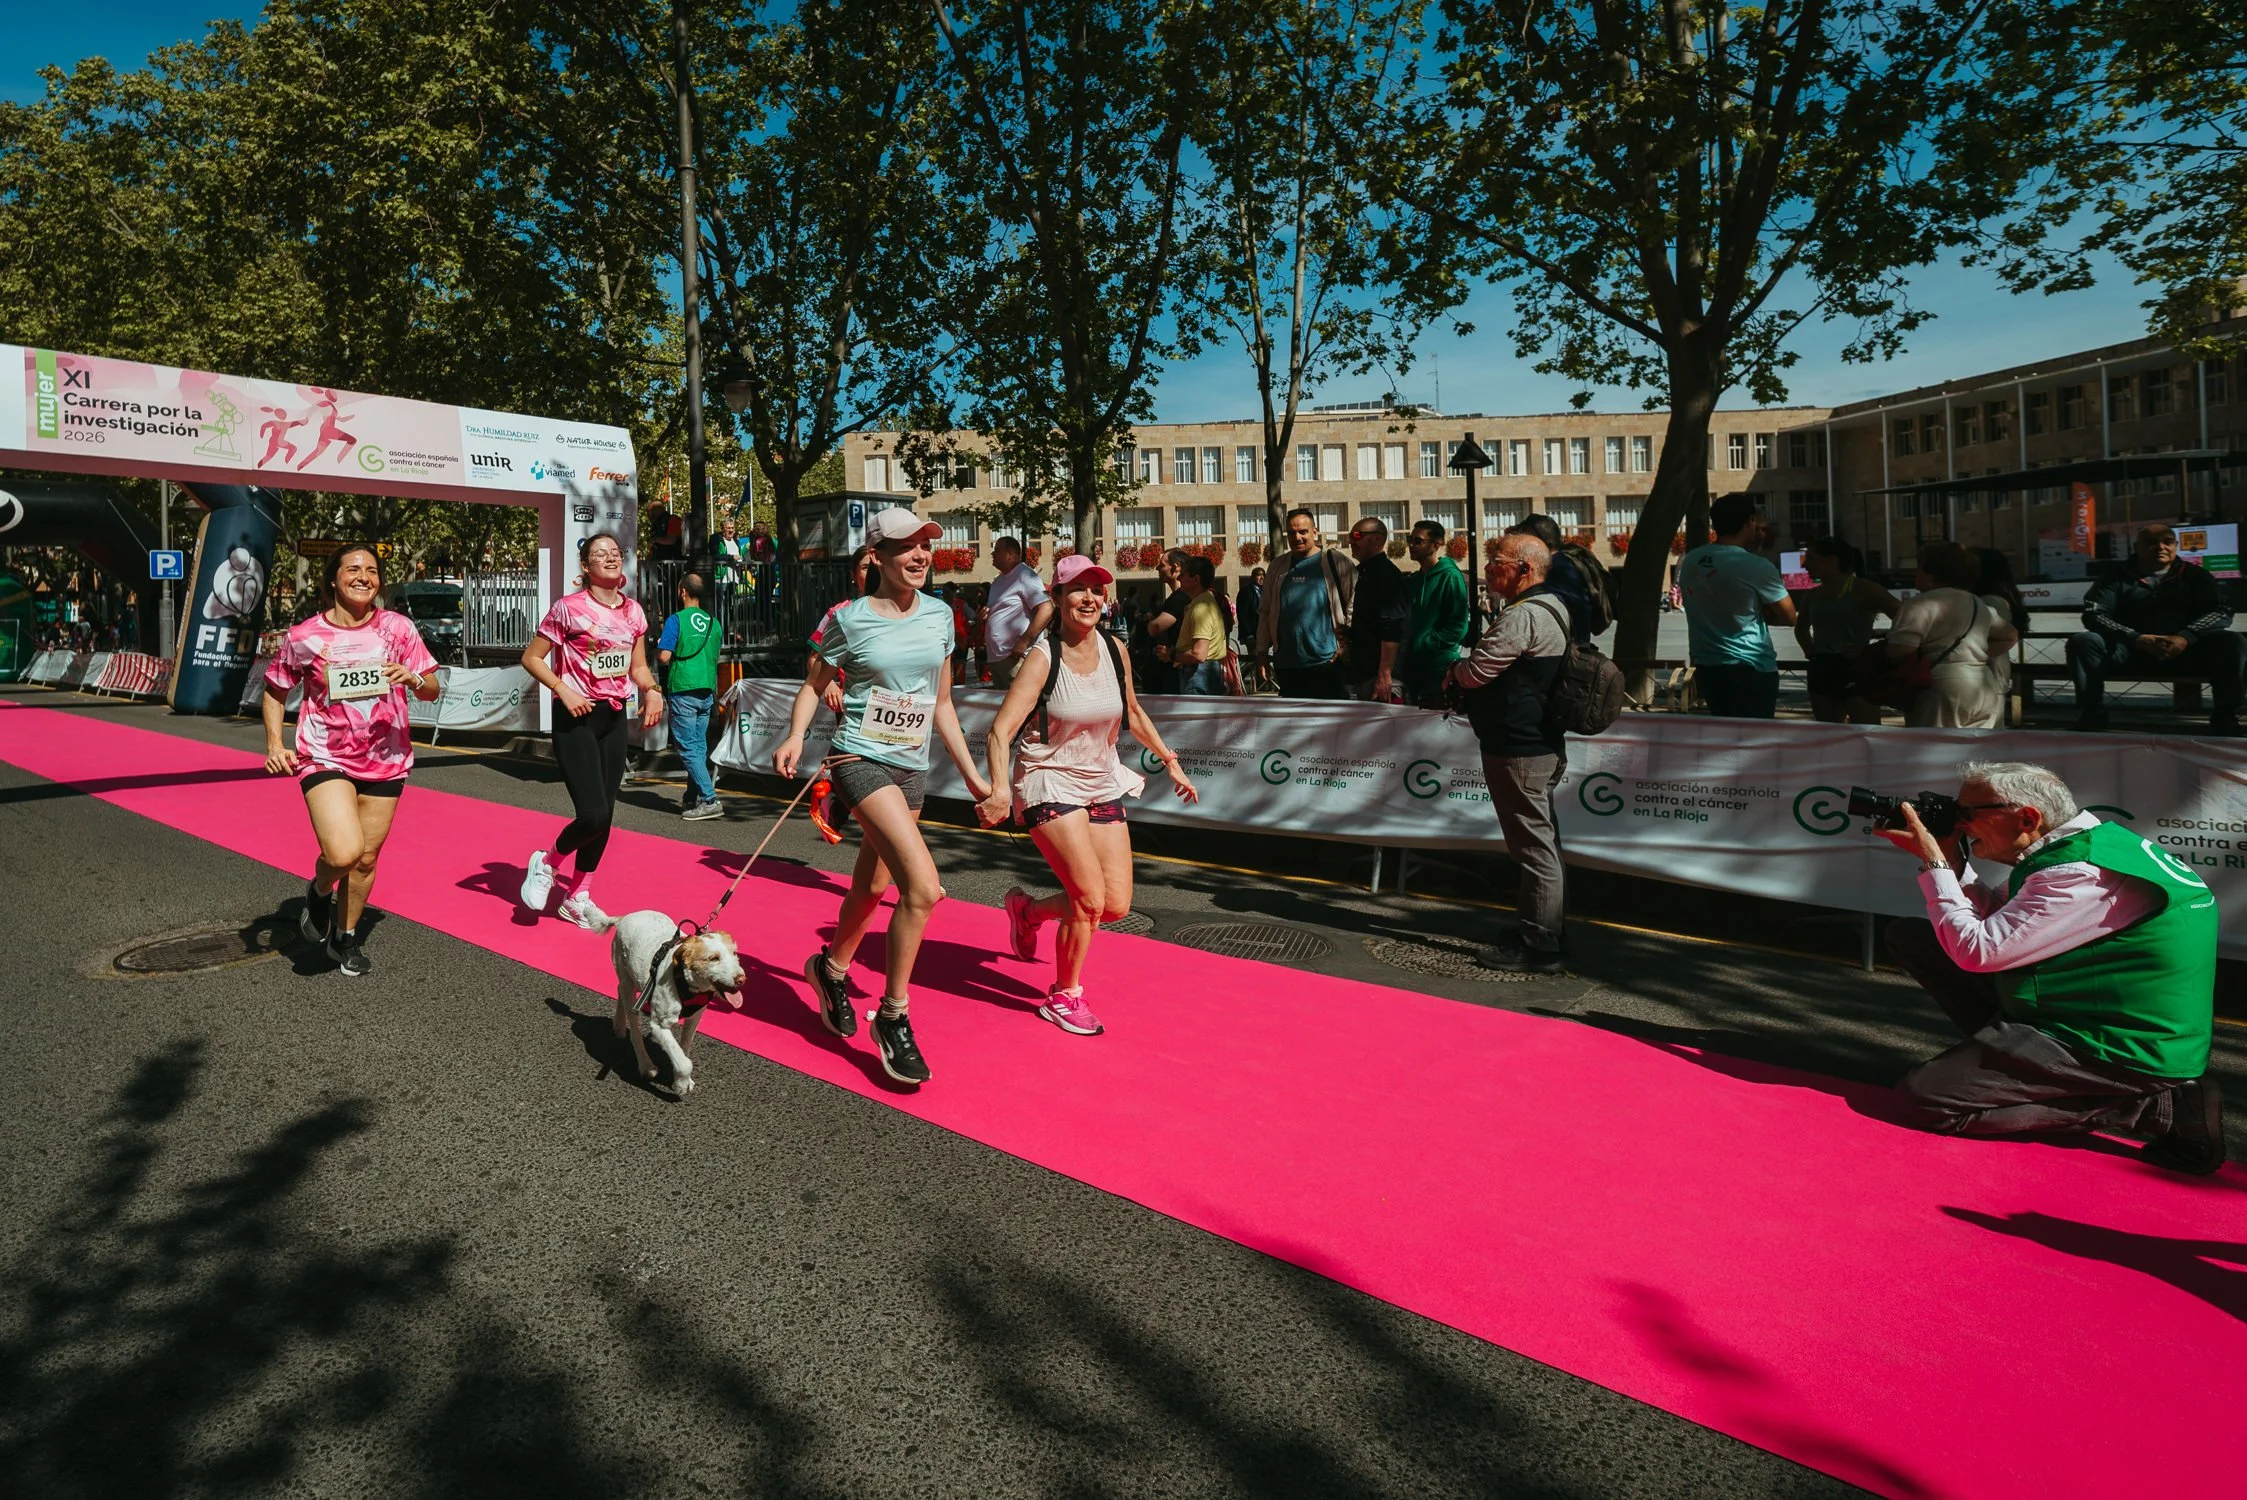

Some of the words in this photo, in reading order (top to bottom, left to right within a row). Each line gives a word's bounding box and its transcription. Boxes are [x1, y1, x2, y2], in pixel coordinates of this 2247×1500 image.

[63, 368, 91, 389] XI
[35, 371, 59, 432] mujer
[63, 392, 142, 414] Carrera
[147, 404, 180, 419] por
[184, 406, 202, 421] la
[64, 410, 199, 438] investigación
[64, 430, 106, 444] 2026
[389, 450, 427, 460] asociación
[427, 454, 459, 464] española
[389, 458, 412, 467] contra
[421, 461, 445, 470] cáncer
[411, 467, 429, 476] Rioja
[545, 467, 576, 479] viamed
[589, 467, 629, 482] Ferrer
[852, 506, 860, 518] P
[156, 553, 177, 576] P
[196, 624, 254, 653] FFD
[192, 658, 210, 668] para
[213, 661, 221, 669] el
[193, 651, 232, 662] Fundación
[598, 655, 625, 669] 5081
[339, 670, 380, 688] 2835
[872, 707, 925, 729] 10599
[1174, 747, 1216, 757] asociación
[1218, 750, 1256, 760] española
[1200, 758, 1207, 766] el
[1209, 758, 1236, 769] cáncer
[1299, 755, 1349, 767] asociación
[1350, 759, 1396, 770] española
[1193, 767, 1214, 778] Rioja
[1298, 766, 1328, 776] contra
[1329, 767, 1339, 777] el
[1340, 769, 1374, 780] cáncer
[1296, 777, 1307, 785] en
[1309, 776, 1321, 787] La
[1323, 778, 1347, 790] Rioja
[1450, 779, 1487, 790] contra
[1635, 780, 1709, 794] asociación
[1712, 786, 1780, 799] española
[1448, 790, 1462, 799] en
[1465, 790, 1479, 801] La
[1634, 793, 1679, 806] contra
[1683, 796, 1695, 807] el
[1698, 798, 1749, 811] cáncer
[1633, 808, 1650, 817] en
[1654, 807, 1670, 819] La
[1674, 808, 1709, 823] Rioja
[2157, 834, 2230, 850] contra
[2191, 852, 2218, 867] La
